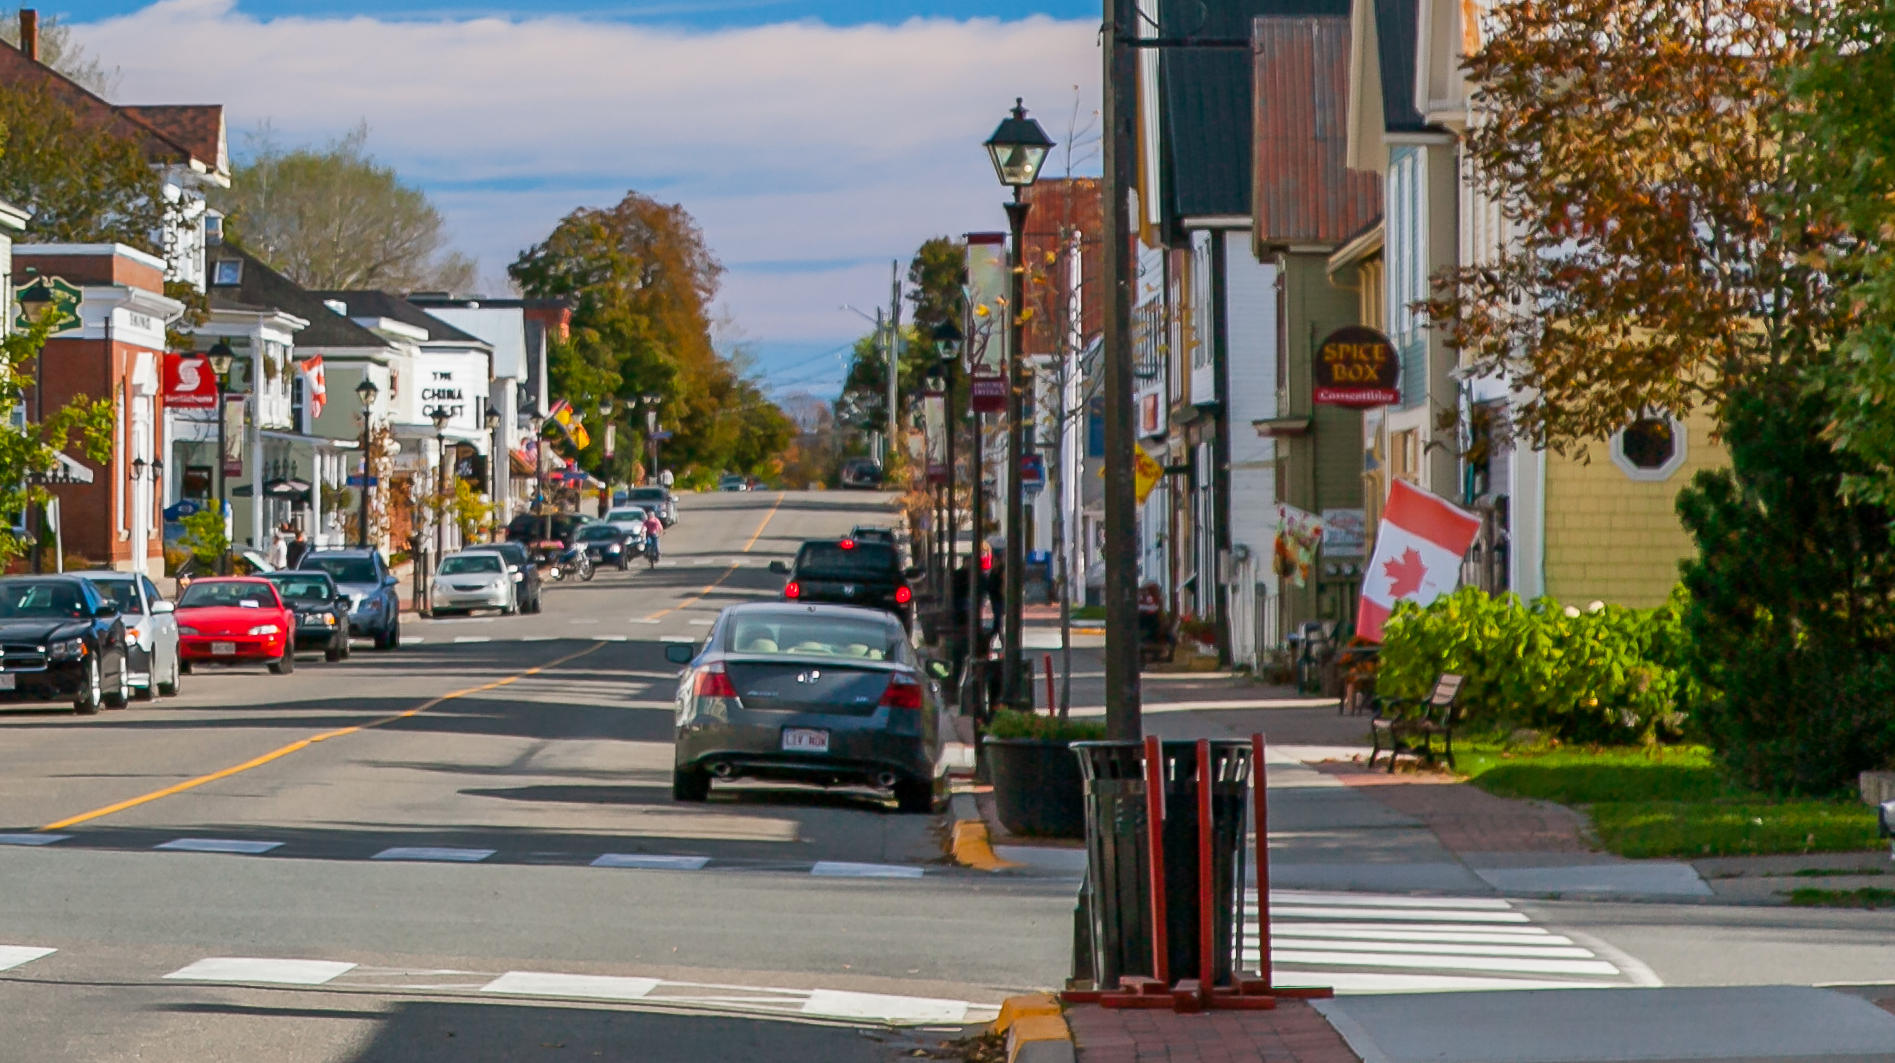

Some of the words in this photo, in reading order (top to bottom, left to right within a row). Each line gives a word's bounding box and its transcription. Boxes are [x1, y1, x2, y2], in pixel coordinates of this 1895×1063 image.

[1323, 343, 1386, 362] SPICE
[432, 371, 452, 380] THE
[1330, 364, 1378, 383] BOX
[421, 388, 463, 400] CHINA
